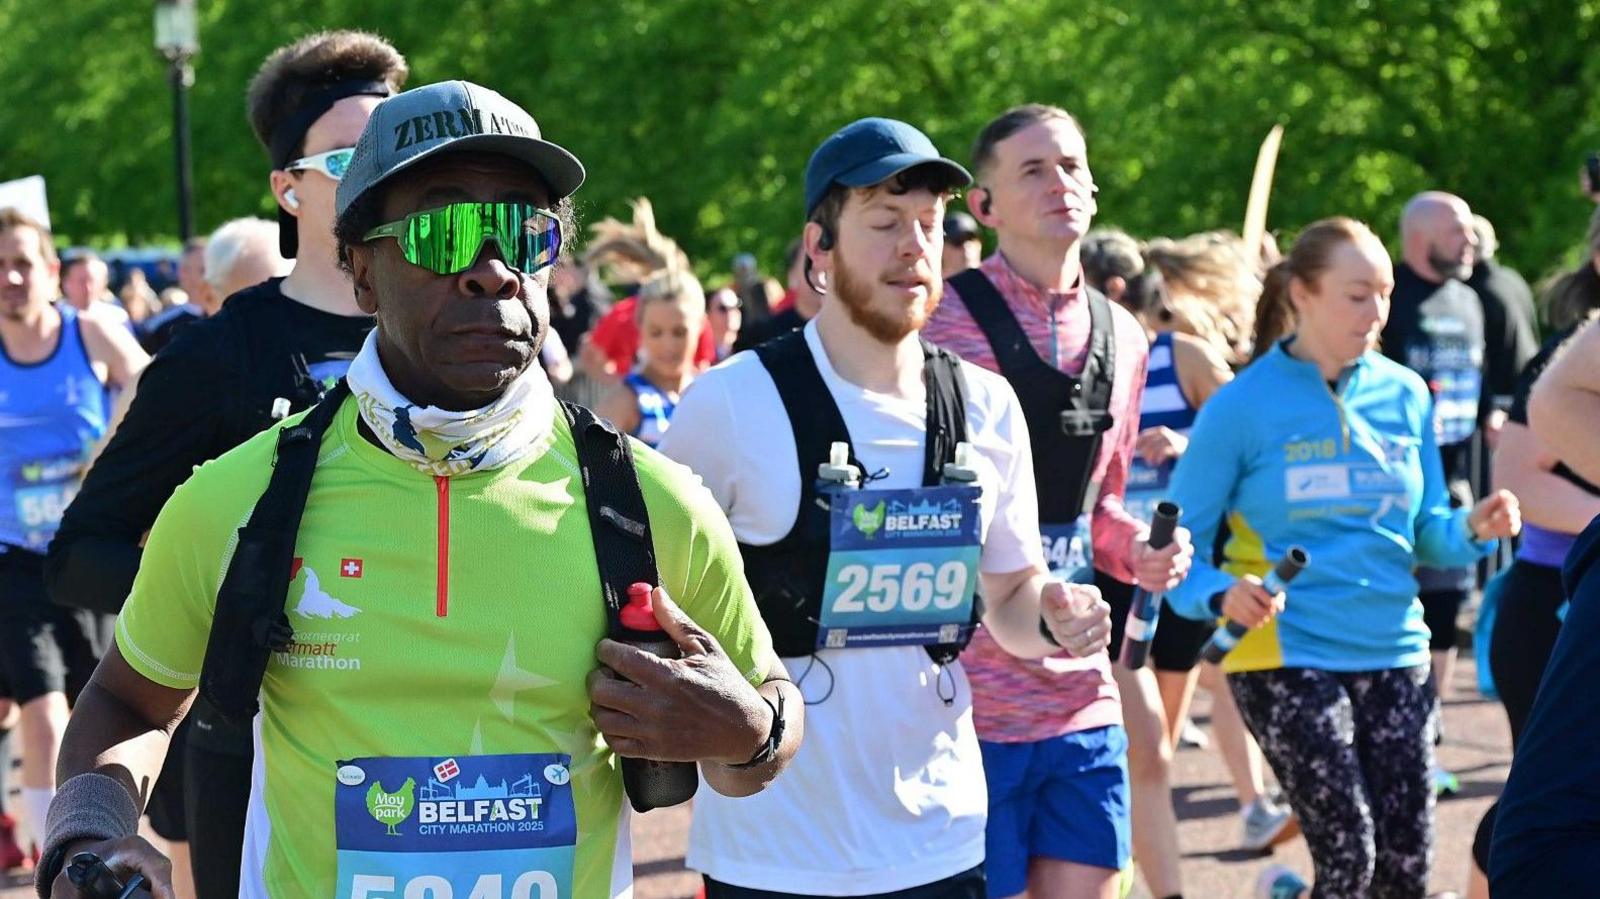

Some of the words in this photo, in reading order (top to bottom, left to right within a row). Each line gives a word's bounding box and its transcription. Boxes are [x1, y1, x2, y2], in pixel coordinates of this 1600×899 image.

[885, 514, 962, 531] BELFAST
[831, 561, 968, 613] 2569
[276, 652, 361, 670] Marathon
[375, 792, 405, 808] Moy
[375, 805, 407, 820] park
[419, 797, 543, 823] BELFAST
[419, 823, 447, 835] CITY
[449, 821, 515, 835] MARATHON
[518, 821, 544, 832] 2025
